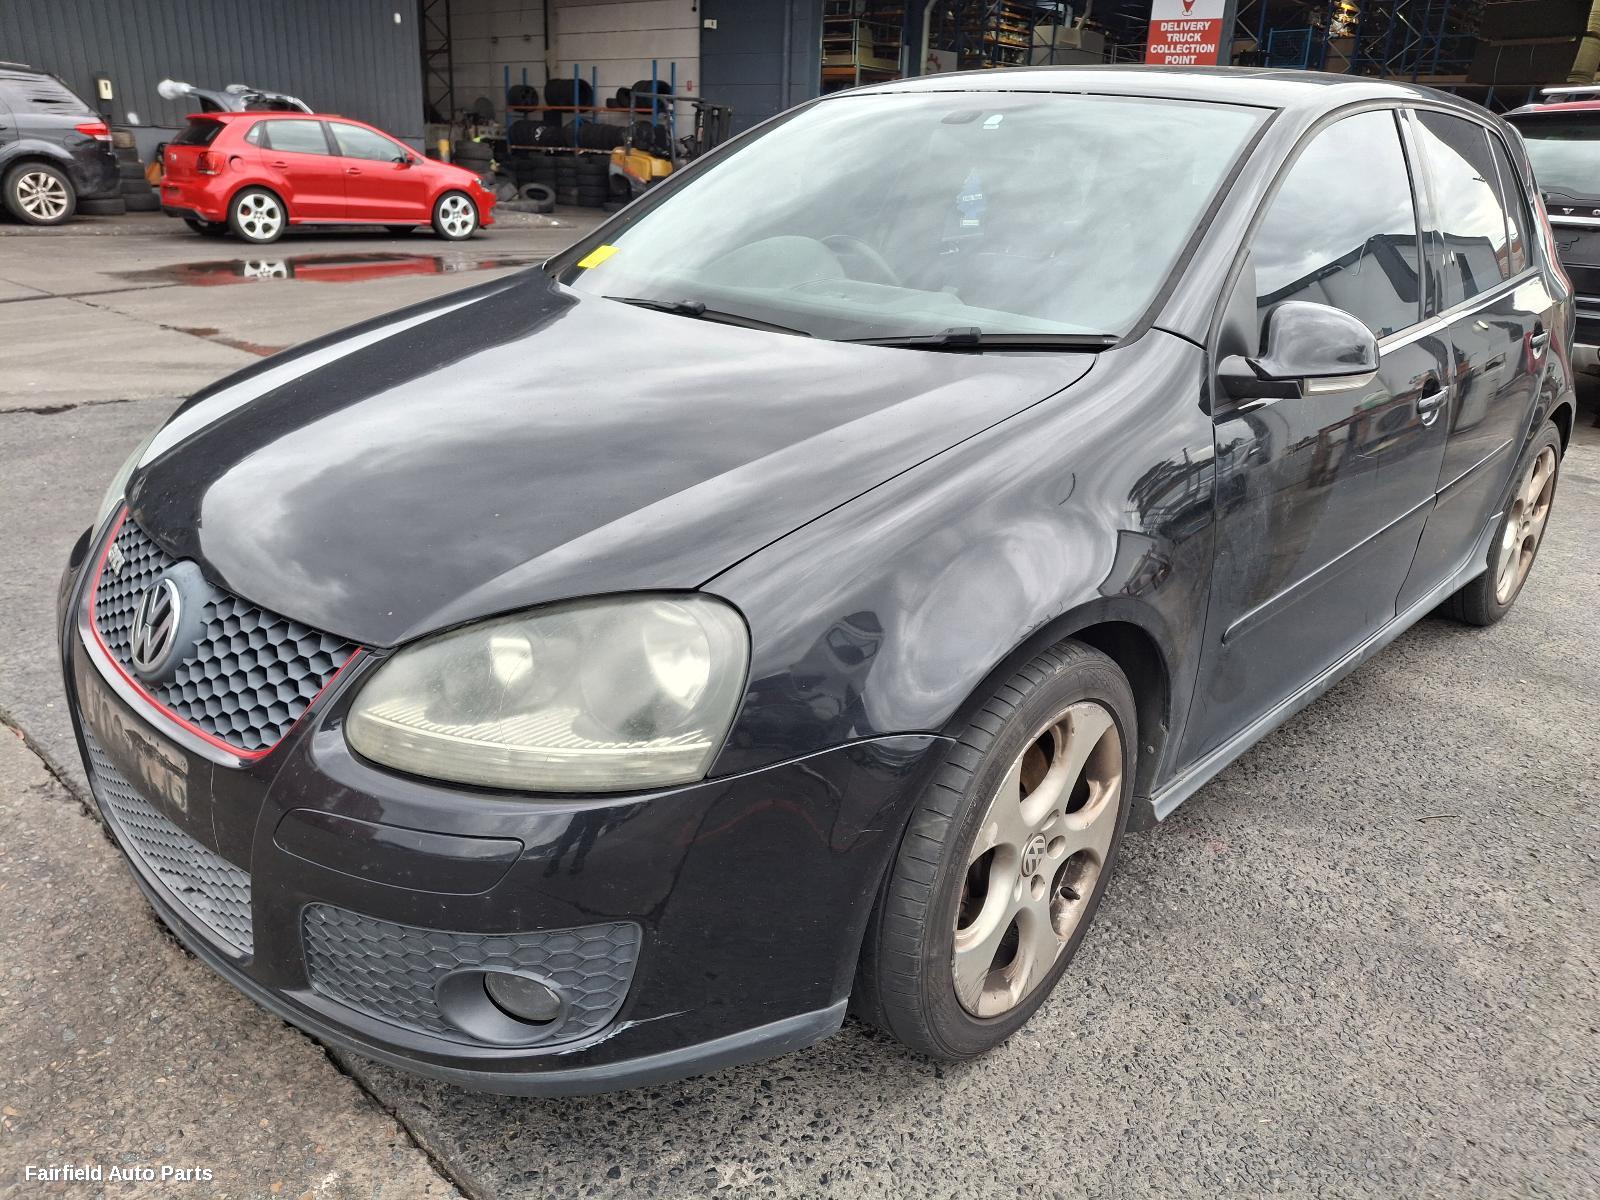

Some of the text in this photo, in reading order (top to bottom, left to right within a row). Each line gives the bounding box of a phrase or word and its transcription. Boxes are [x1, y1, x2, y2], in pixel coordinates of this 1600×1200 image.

[1160, 21, 1211, 31] DELIVERY
[1166, 32, 1202, 42] TRUCK
[1150, 44, 1216, 53] COLLECTION
[1164, 55, 1197, 65] POINT
